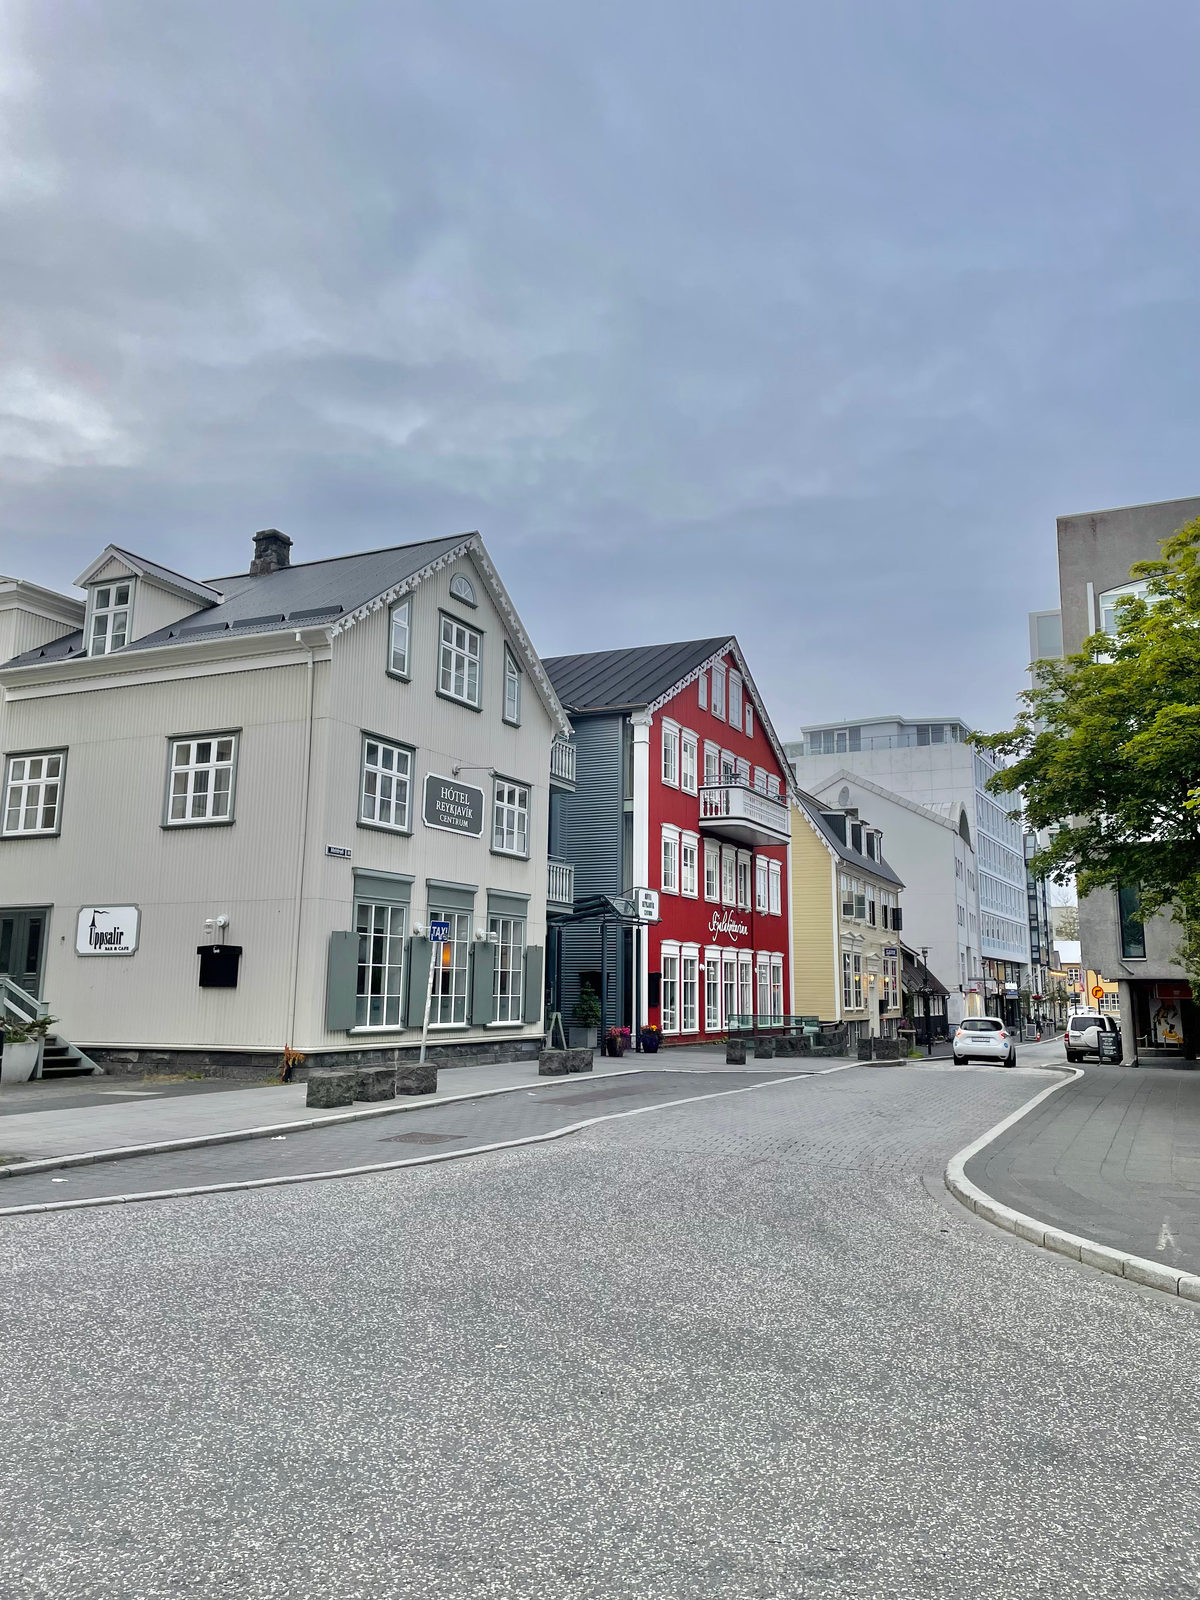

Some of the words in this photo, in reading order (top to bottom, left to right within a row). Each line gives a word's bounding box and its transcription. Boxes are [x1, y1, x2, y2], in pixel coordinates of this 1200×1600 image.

[440, 786, 470, 805] HÓTEL
[435, 800, 473, 819] REYKJAVÍK
[439, 814, 469, 828] CENTRUM
[89, 926, 124, 950] Uppsalir
